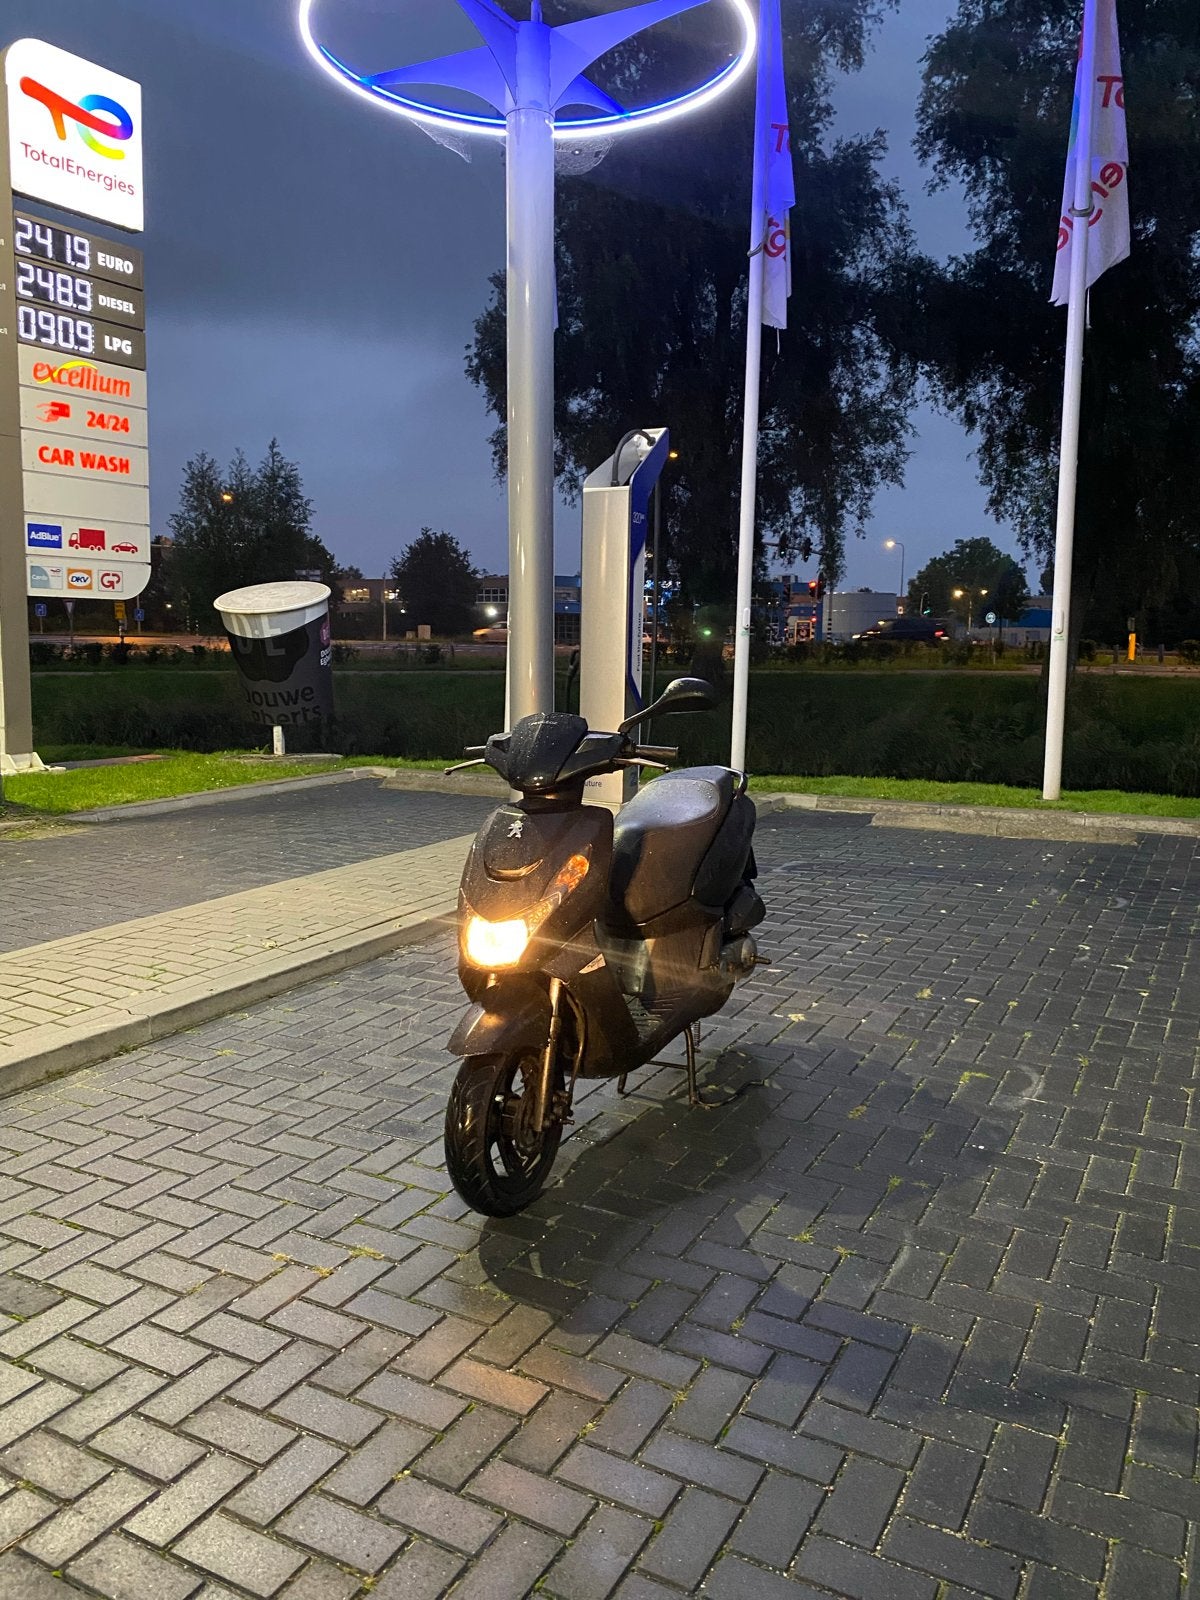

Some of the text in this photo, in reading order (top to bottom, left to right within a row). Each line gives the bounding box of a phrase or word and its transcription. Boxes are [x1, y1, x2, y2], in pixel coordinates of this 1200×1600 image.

[20, 141, 135, 196] TotalEnergies
[97, 252, 134, 274] EURO
[98, 294, 136, 315] DIESEL
[104, 335, 132, 354] LPG
[33, 362, 131, 397] excellium
[87, 411, 130, 433] 24/24
[38, 446, 130, 474] CAR WASH
[30, 531, 59, 541] AdBlue
[71, 575, 89, 583] DKV
[584, 780, 602, 788] uture
